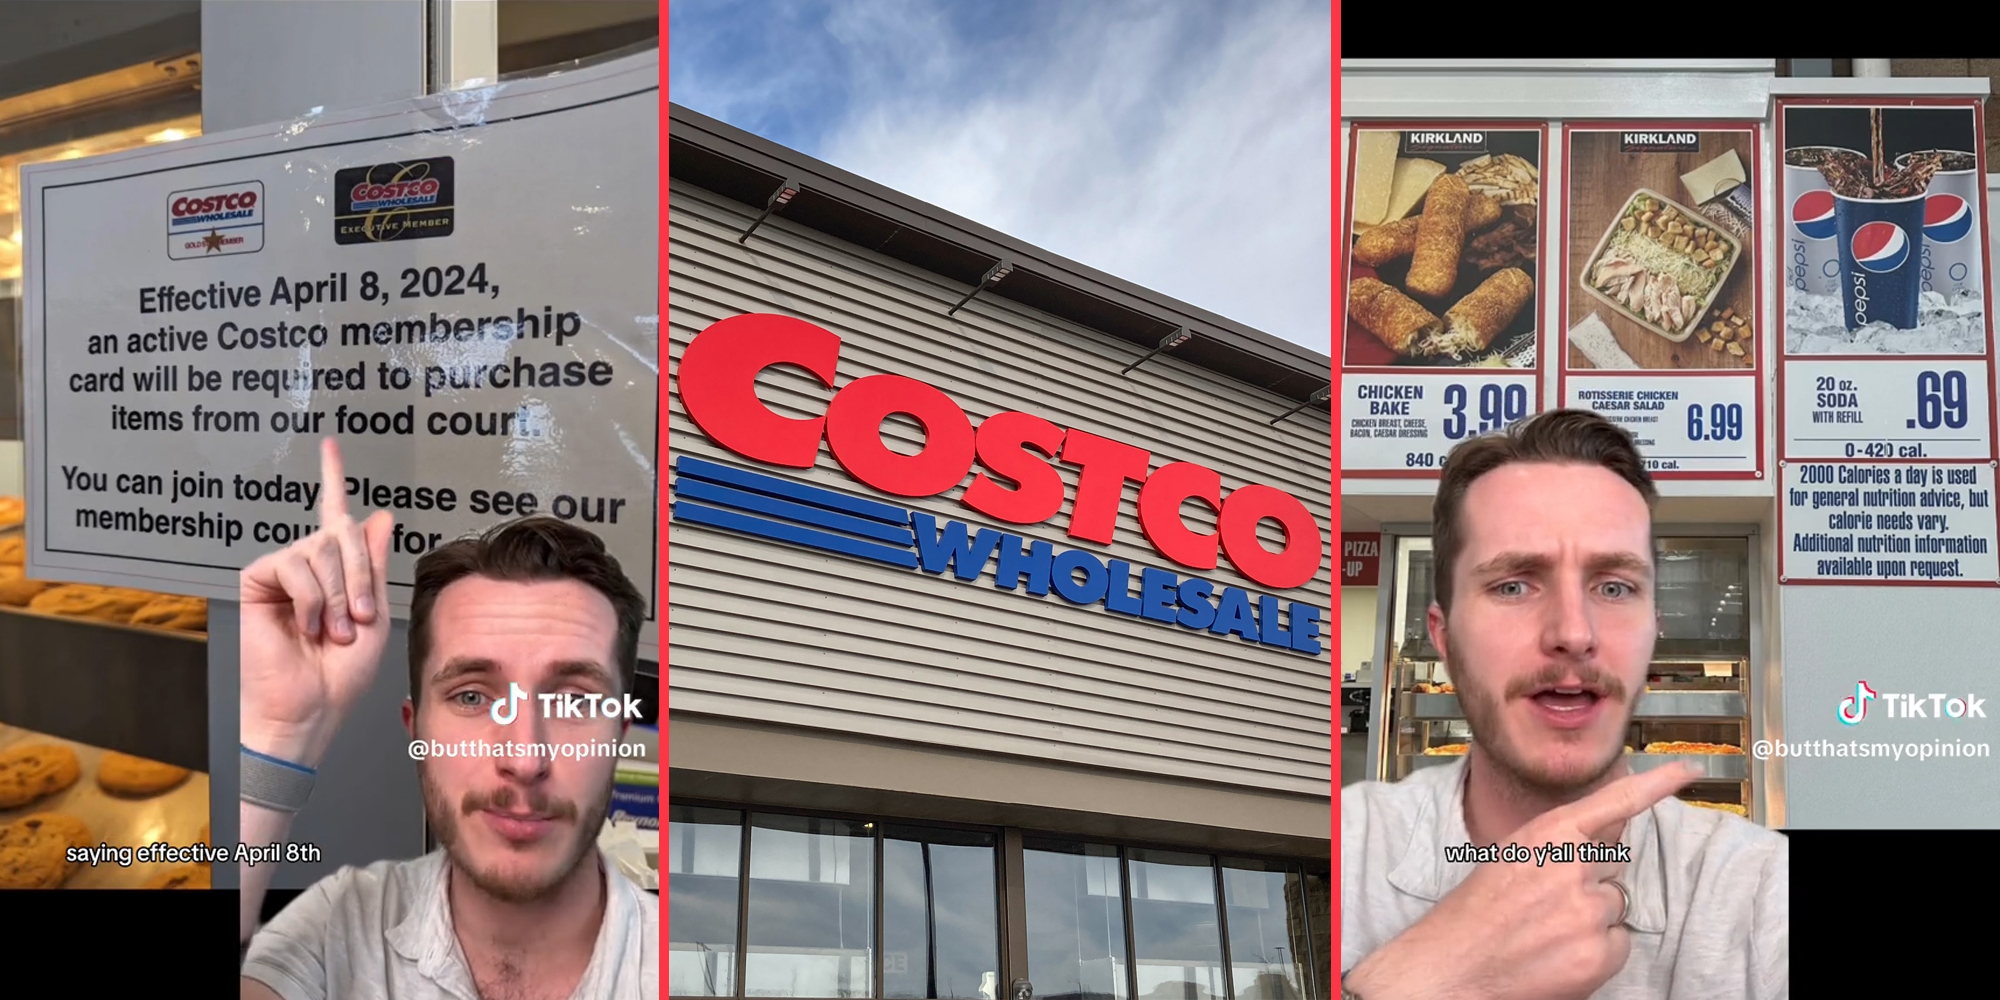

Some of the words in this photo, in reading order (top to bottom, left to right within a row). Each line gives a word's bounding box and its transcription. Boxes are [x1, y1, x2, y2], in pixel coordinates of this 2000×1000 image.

[1411, 133, 1483, 143] KIRKLAND
[1624, 133, 1697, 144] KIRKLAND
[352, 179, 439, 202] COSTCO
[377, 195, 436, 207] WHOLESALE
[172, 191, 258, 217] COSTCO
[196, 209, 254, 223] WHOLESALE
[340, 222, 399, 235] EXECUTIVE
[403, 218, 450, 229] MEMBER
[185, 241, 201, 249] GOLD
[219, 236, 244, 246] EMBER
[1791, 239, 1809, 292] pepsi
[140, 281, 261, 313] Effective
[269, 272, 347, 311] April
[359, 271, 389, 306] 8,
[400, 263, 500, 299] 2024,
[1851, 271, 1869, 326] pepsi
[88, 333, 118, 354] an
[127, 325, 208, 353] active
[217, 321, 328, 350] Costco
[341, 306, 581, 346] membership
[69, 367, 124, 392] card
[133, 365, 177, 392] will
[188, 365, 222, 391] be
[232, 361, 365, 398] required
[378, 362, 411, 390] to
[425, 357, 613, 397] purchase
[1816, 376, 1835, 391] 20
[1839, 380, 1858, 391] oz.
[1358, 385, 1423, 399] CHICKEN
[1578, 391, 1634, 400] ROTISSERIE
[1637, 391, 1678, 400] CHICKEN
[1817, 393, 1858, 408] SODA
[1906, 370, 1968, 429] .69
[1370, 401, 1409, 415] BAKE
[1443, 384, 1527, 439] 3.99
[1592, 401, 1630, 410] CAESAR
[1633, 401, 1665, 410] SALAD
[111, 405, 183, 431] items
[192, 405, 259, 432] from
[270, 411, 325, 433] our
[335, 405, 414, 435] food
[1352, 419, 1377, 428] CHICKEN
[1688, 403, 1742, 441] 6.99
[1812, 411, 1834, 423] WITH
[1836, 411, 1863, 423] REFILL
[1374, 429, 1397, 438] CAESAR
[1399, 429, 1428, 438] DRESSING
[677, 313, 1322, 589] COSTCO
[1406, 453, 1433, 467] 840
[1899, 443, 1927, 458] cal.
[1661, 460, 1679, 470] cal.
[1800, 465, 1834, 484] 2000
[1839, 465, 1890, 484] Calories
[1895, 469, 1902, 484] a
[1906, 466, 1927, 487] day
[1932, 466, 1943, 484] is
[1947, 466, 1976, 485] used
[62, 465, 107, 492] You
[116, 472, 162, 495] can
[171, 470, 223, 503] join
[233, 474, 321, 511] today
[469, 490, 538, 515] see
[552, 493, 626, 524] our
[1790, 488, 1808, 506] for
[1813, 488, 1858, 509] general
[1863, 488, 1916, 507] nutrition
[1920, 489, 1964, 510] advice,
[1969, 489, 1988, 508] but
[76, 507, 243, 547] membership
[392, 523, 442, 554] for
[1829, 511, 1872, 529] calorie
[1877, 512, 1913, 530] needs
[1918, 515, 1949, 533] vary.
[1344, 541, 1378, 557] PIZZA
[1793, 533, 1853, 552] Additional
[1858, 534, 1910, 553] nutrition
[1915, 535, 1987, 554] information
[1818, 557, 1872, 576] available
[1877, 561, 1905, 579] upon
[1911, 559, 1963, 579] request.
[910, 511, 1321, 655] WHOLESALE
